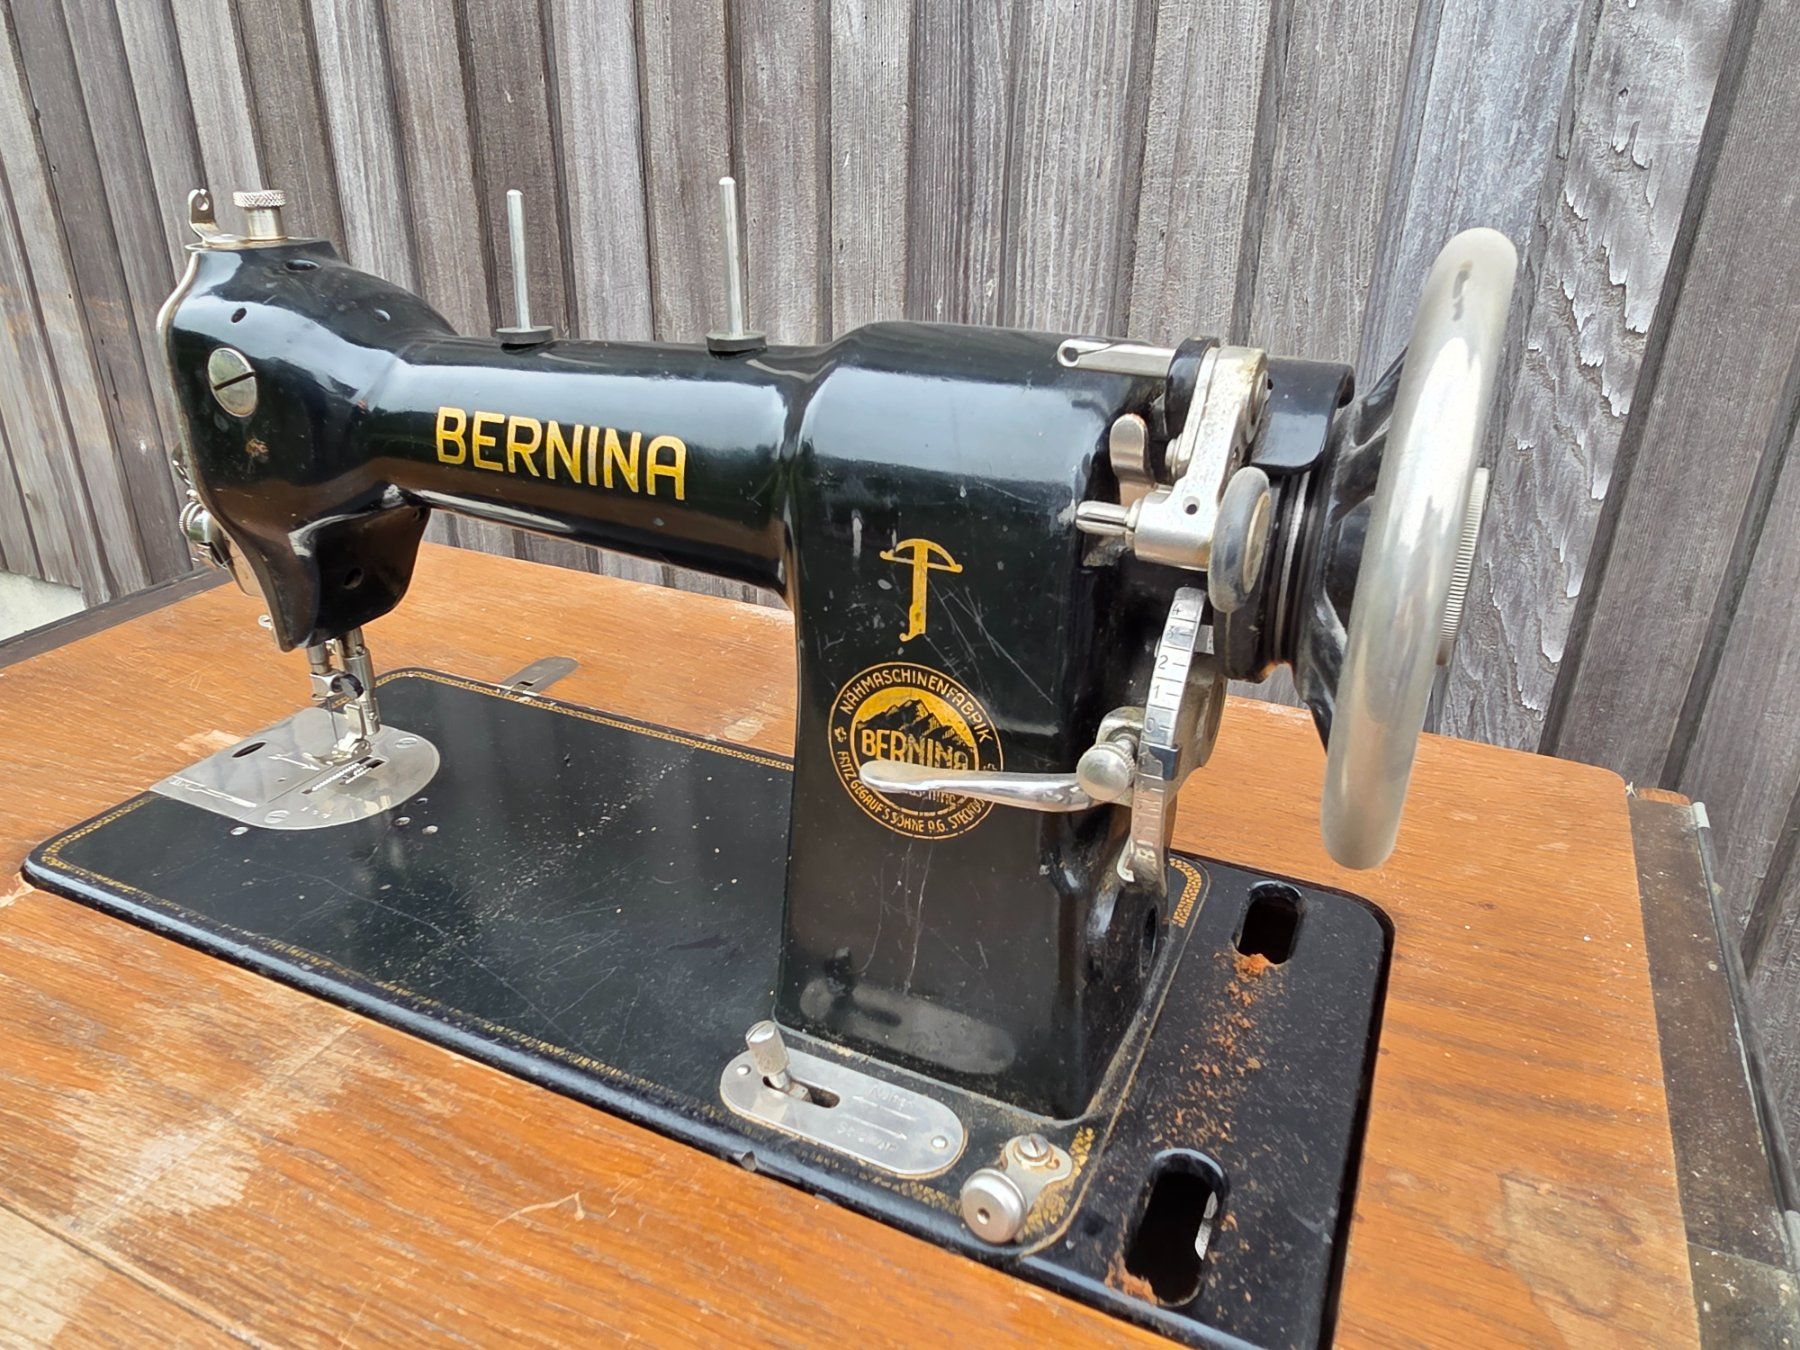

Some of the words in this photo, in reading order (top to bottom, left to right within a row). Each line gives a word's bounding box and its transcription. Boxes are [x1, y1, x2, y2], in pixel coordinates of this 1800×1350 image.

[435, 406, 687, 500] BERNINA
[1157, 654, 1169, 670] 2
[839, 668, 994, 744] NÄHMASCHINENFABRIK
[837, 750, 858, 781] FRITZ
[861, 728, 969, 771] BERNINA
